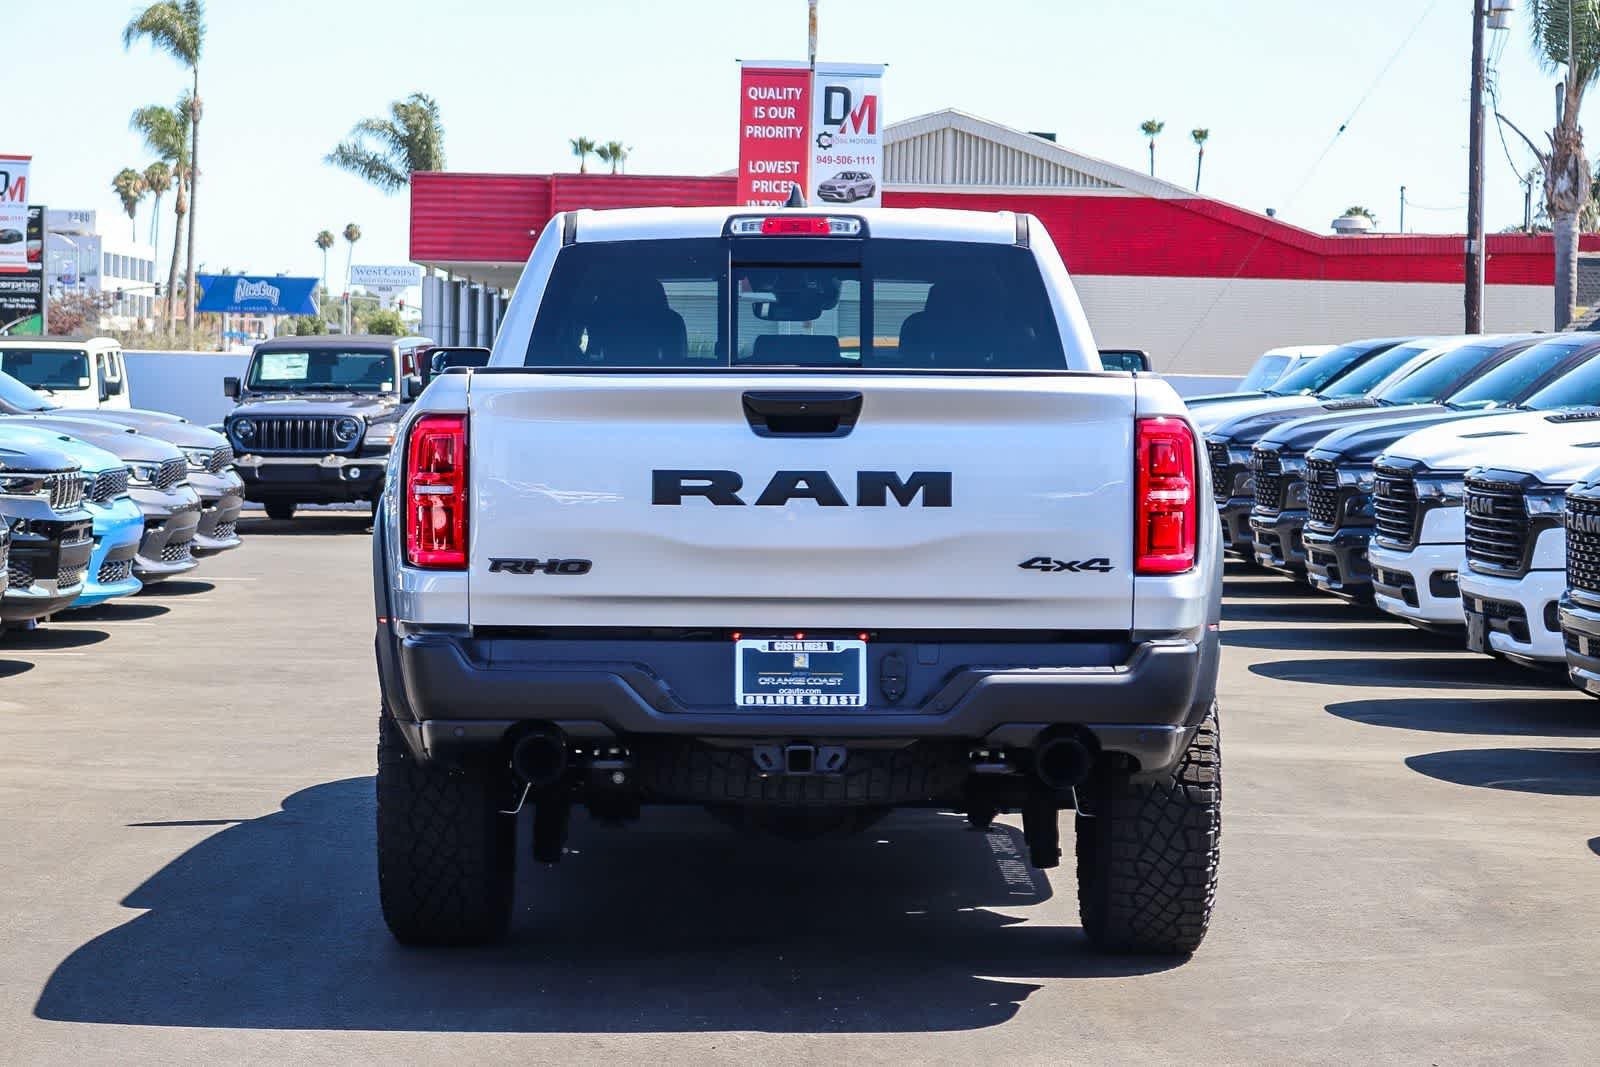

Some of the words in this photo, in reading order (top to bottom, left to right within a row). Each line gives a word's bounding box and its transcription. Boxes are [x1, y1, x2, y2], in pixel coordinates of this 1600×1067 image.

[748, 87, 802, 100] QUALITY
[754, 107, 766, 119] IS
[768, 107, 796, 119] OUR
[746, 126, 803, 139] PRIORITY
[816, 155, 876, 165] 949-506-1111
[749, 161, 800, 174] LOWEST
[355, 266, 382, 276] West
[383, 267, 417, 278] Coast
[651, 469, 953, 507] RAM
[488, 558, 593, 575] RHO
[1017, 557, 1115, 572] 4x4
[774, 642, 803, 651] COSTA
[804, 642, 828, 651] MESA
[758, 677, 806, 685] ORANGE
[806, 677, 843, 686] COAST
[745, 695, 804, 705] ORANGE
[809, 695, 858, 705] COAST
